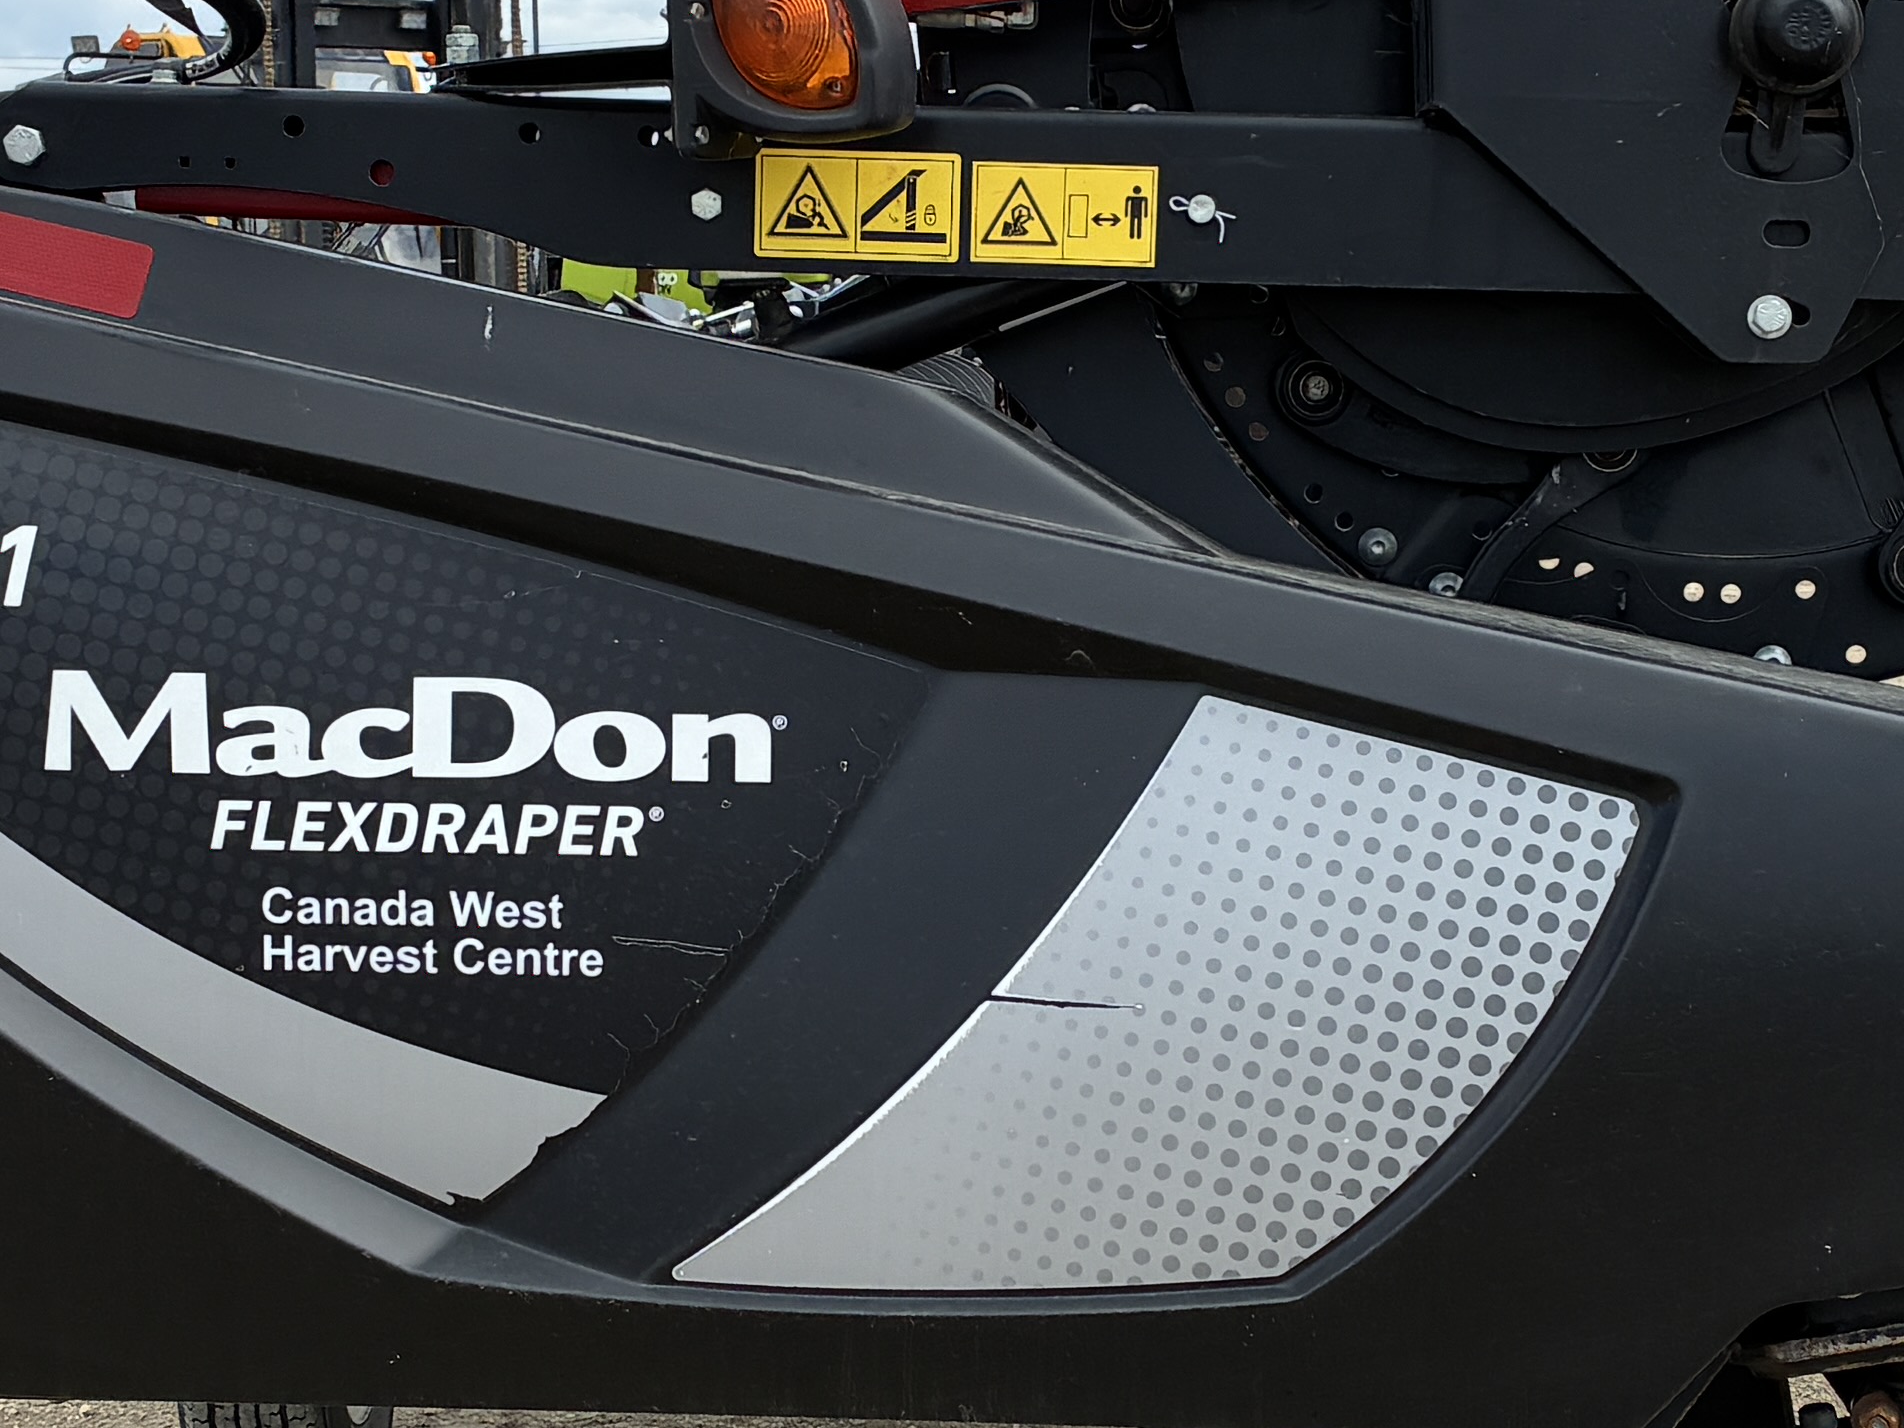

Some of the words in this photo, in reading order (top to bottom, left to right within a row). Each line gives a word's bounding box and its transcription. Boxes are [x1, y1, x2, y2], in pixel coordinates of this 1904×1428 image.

[261, 886, 435, 927] Canada
[448, 890, 564, 930] West
[263, 934, 439, 975] Harvest
[453, 937, 604, 978] Centre
